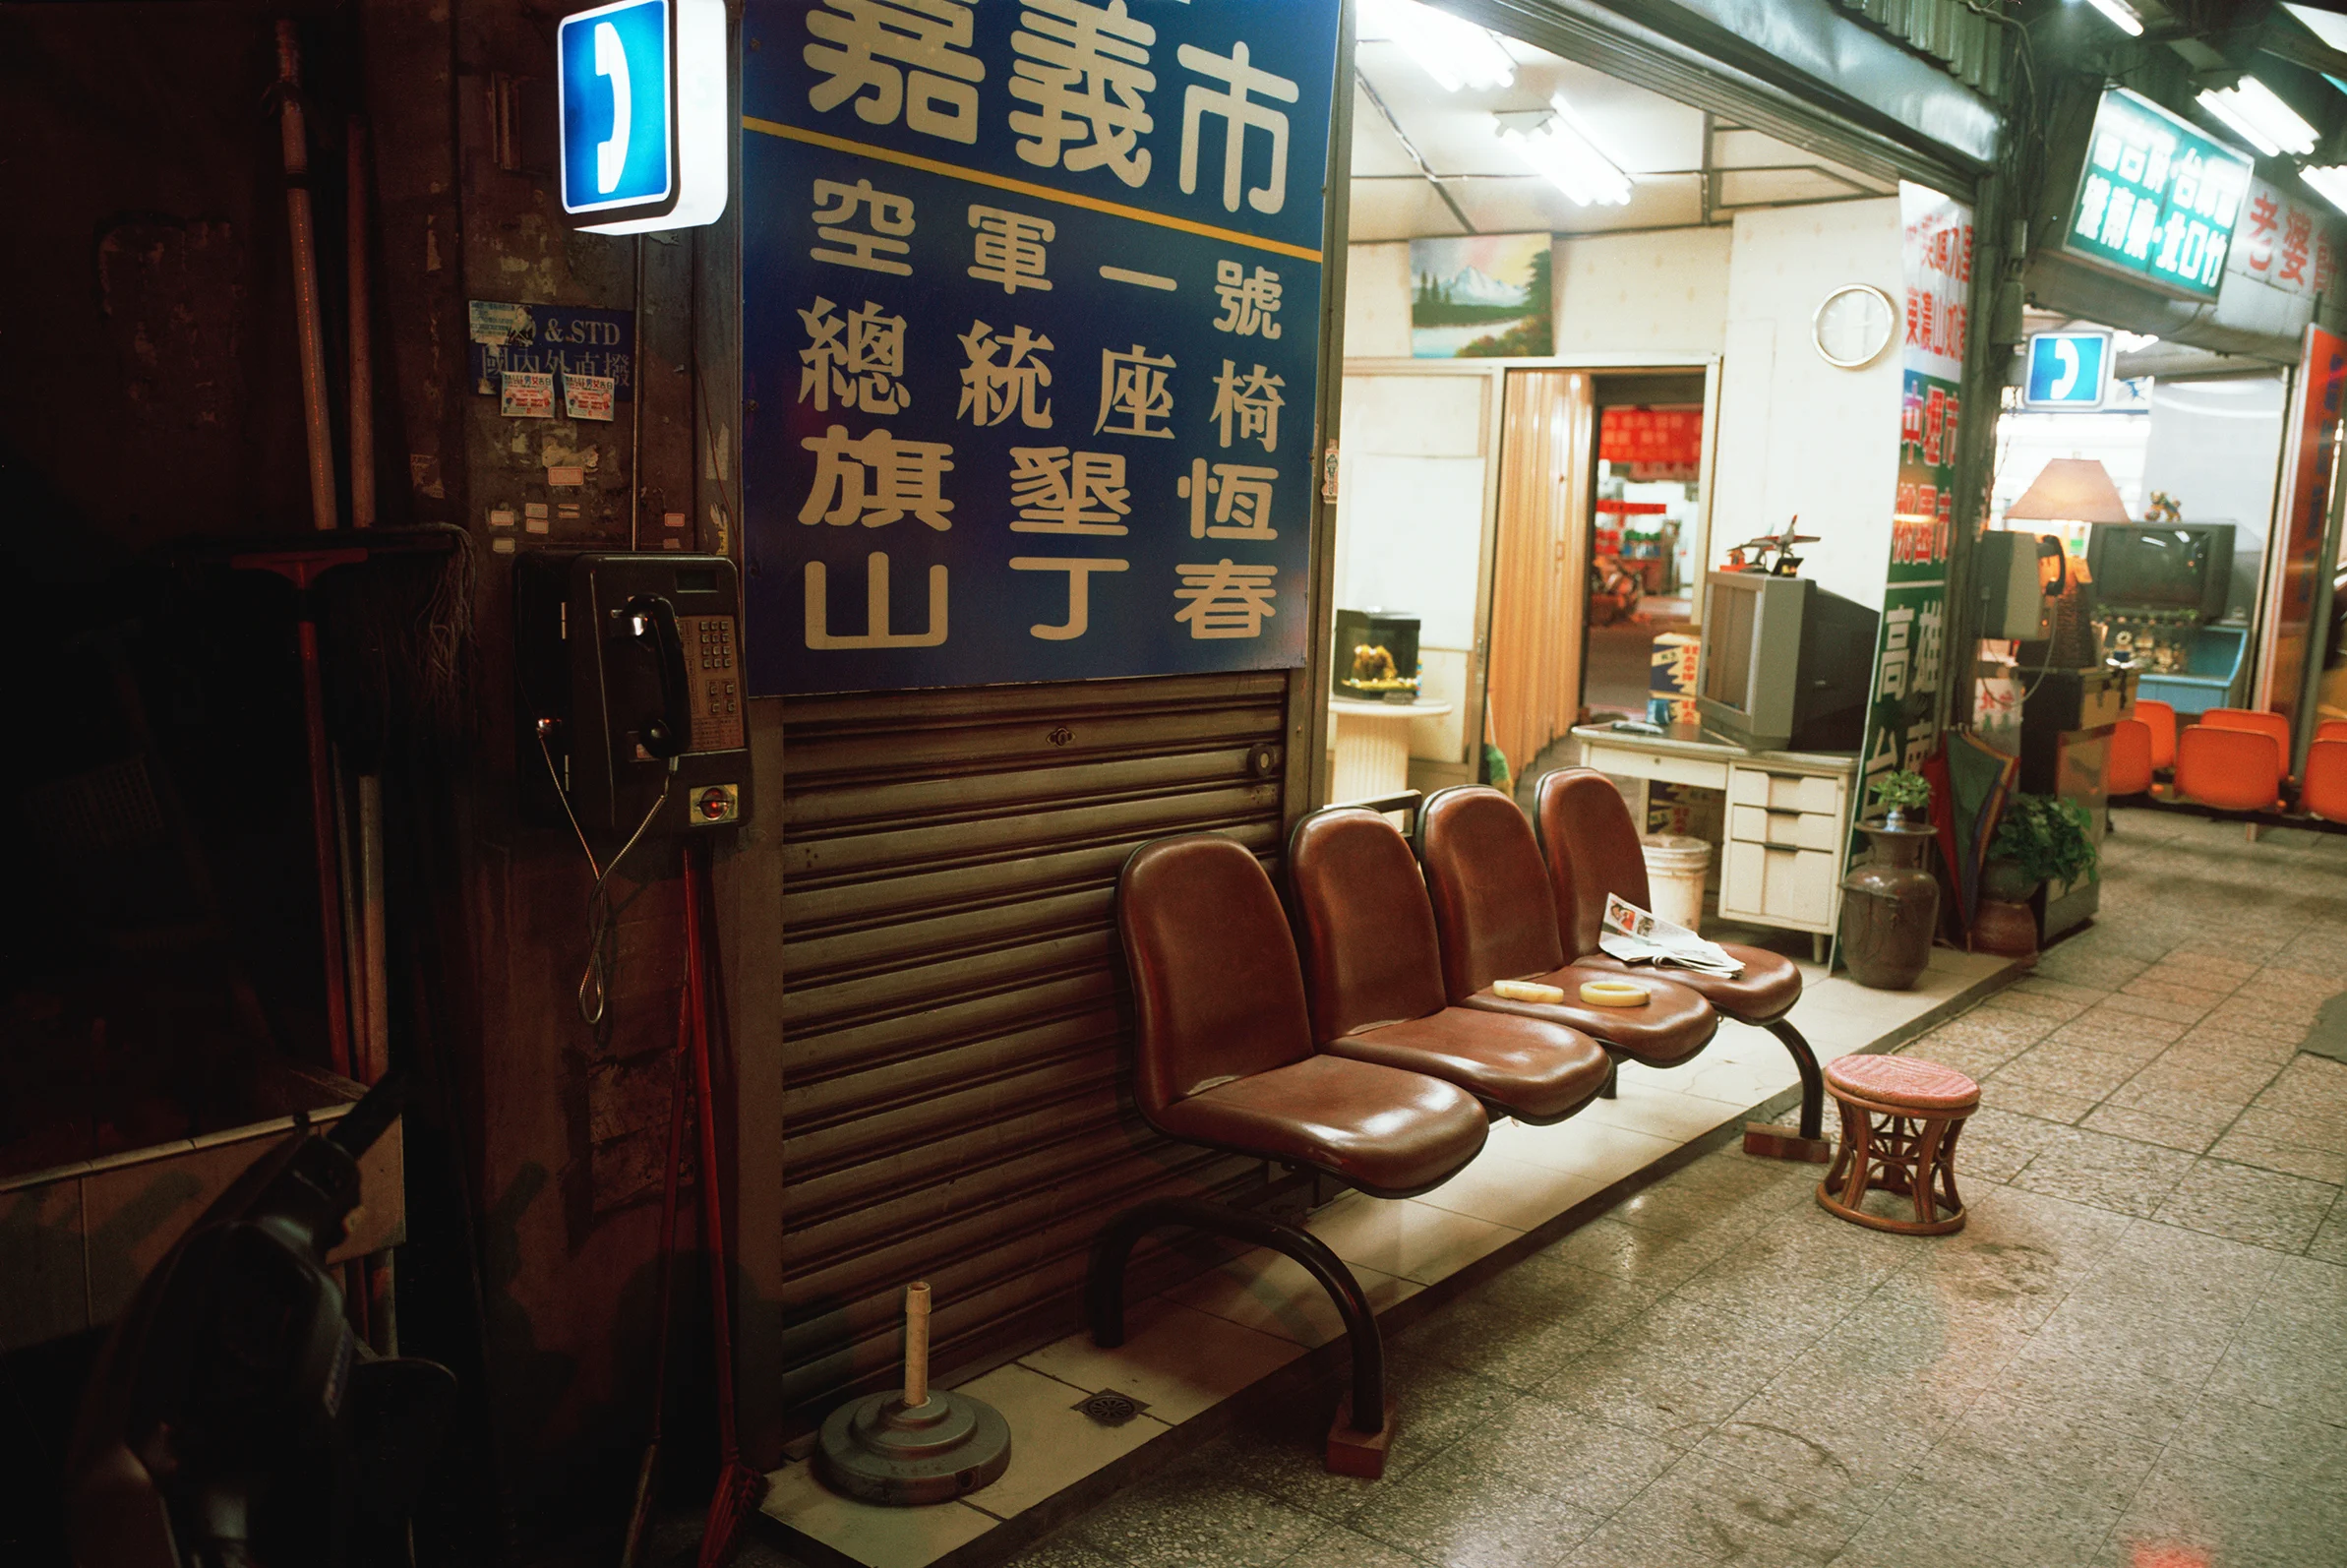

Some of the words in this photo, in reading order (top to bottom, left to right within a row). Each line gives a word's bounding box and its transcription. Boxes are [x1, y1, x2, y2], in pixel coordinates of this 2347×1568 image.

[803, 0, 1299, 214] 嘉義市
[572, 321, 621, 345] STD
[810, 178, 1283, 339] 空軍一號
[797, 296, 1286, 452] 總統座椅
[797, 424, 955, 651] 旗山
[1008, 446, 1132, 641] 墾丁
[1173, 456, 1279, 639] 恆春
